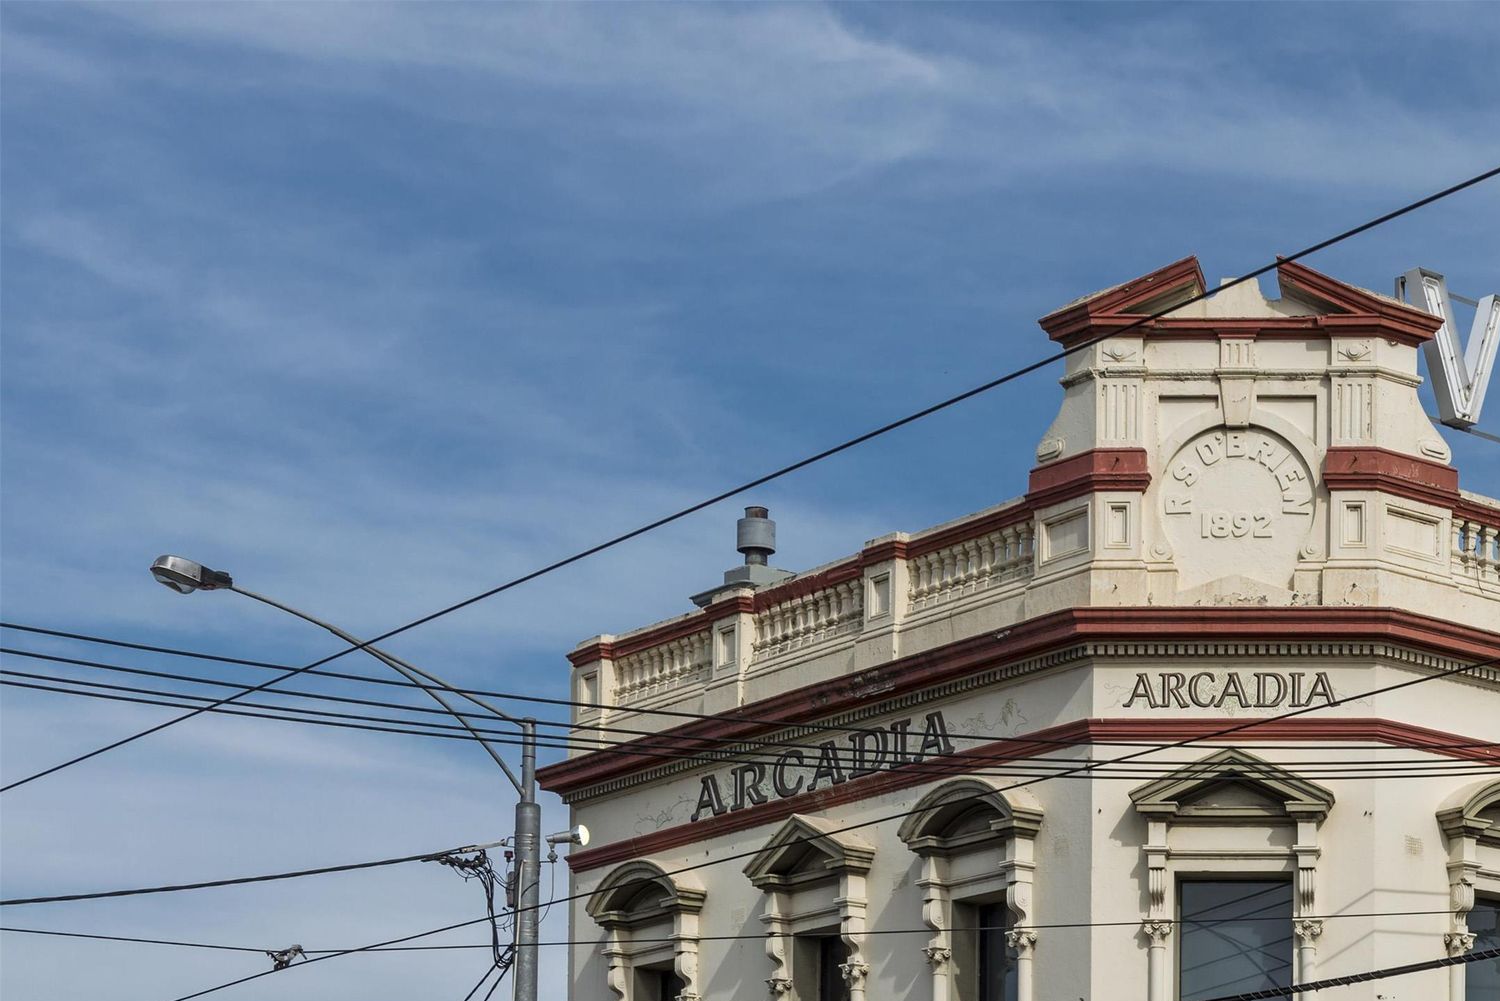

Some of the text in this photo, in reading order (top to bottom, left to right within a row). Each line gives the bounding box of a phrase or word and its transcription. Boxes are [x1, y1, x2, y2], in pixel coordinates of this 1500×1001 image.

[1195, 431, 1311, 515] O'BRIEN
[1200, 512, 1273, 539] 1892
[1122, 671, 1341, 709] ARCADIA
[690, 710, 956, 822] ARCADIA
